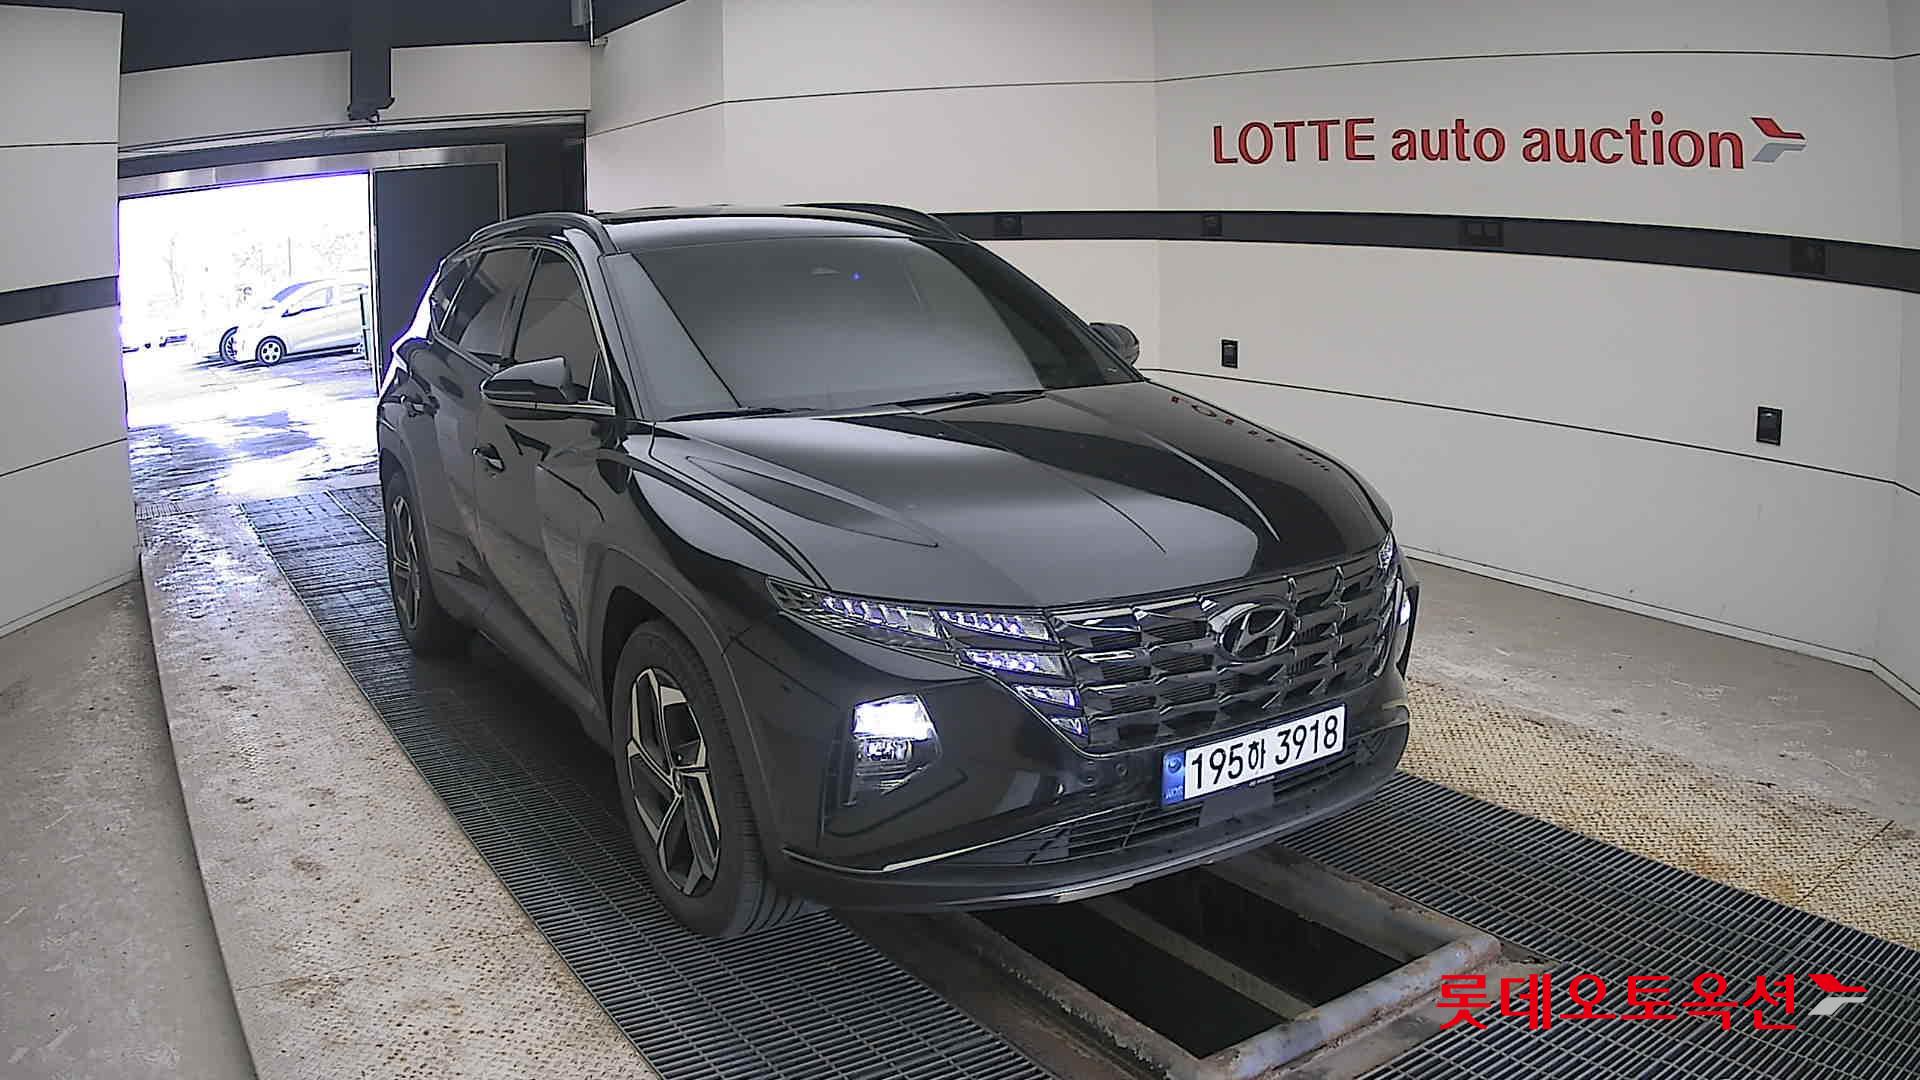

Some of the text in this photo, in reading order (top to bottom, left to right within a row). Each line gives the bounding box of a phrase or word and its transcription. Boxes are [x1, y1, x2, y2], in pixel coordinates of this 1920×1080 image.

[1212, 110, 1745, 170] LOTTE auto auction
[1191, 715, 1339, 790] 195하 3918
